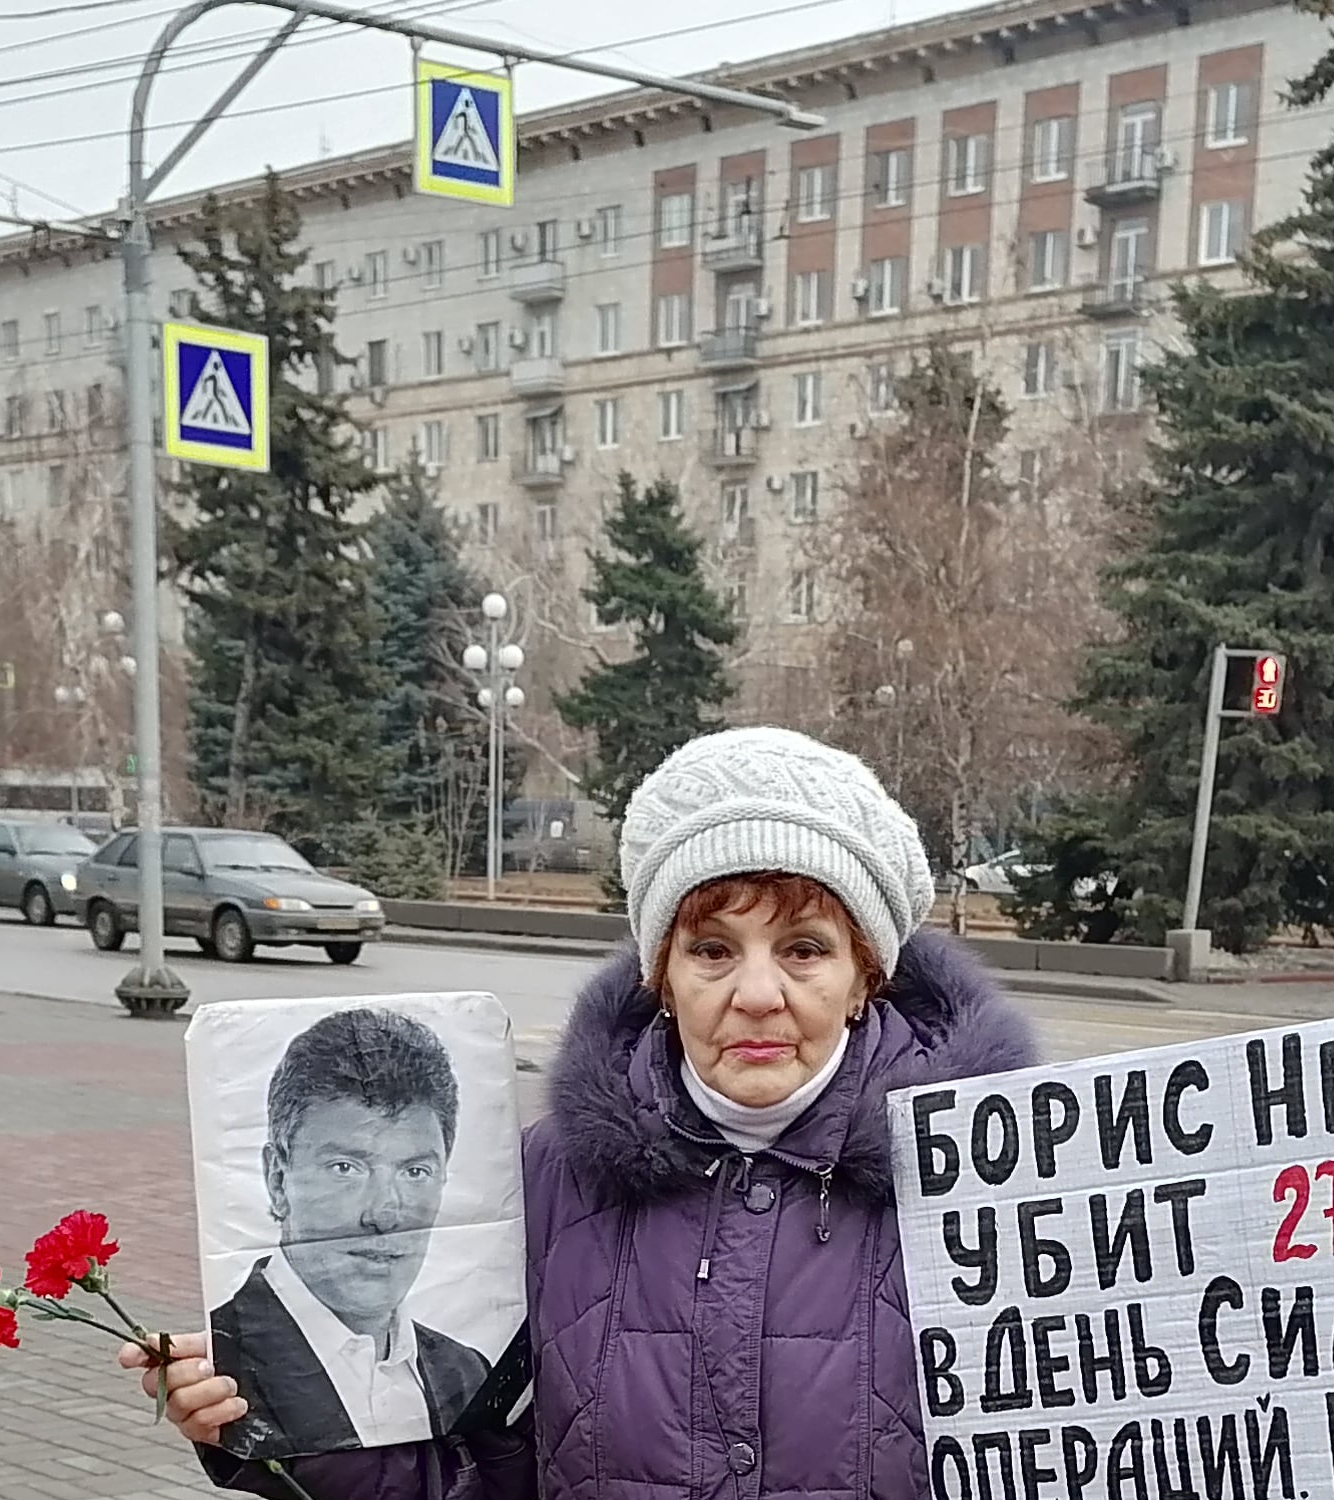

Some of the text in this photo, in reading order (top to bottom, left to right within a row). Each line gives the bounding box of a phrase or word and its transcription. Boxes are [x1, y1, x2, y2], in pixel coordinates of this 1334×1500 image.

[911, 1058, 1215, 1198] БОРИС
[941, 1177, 1208, 1307] УБИТ
[918, 1326, 966, 1419] В
[978, 1301, 1174, 1415] ДЕНЬ
